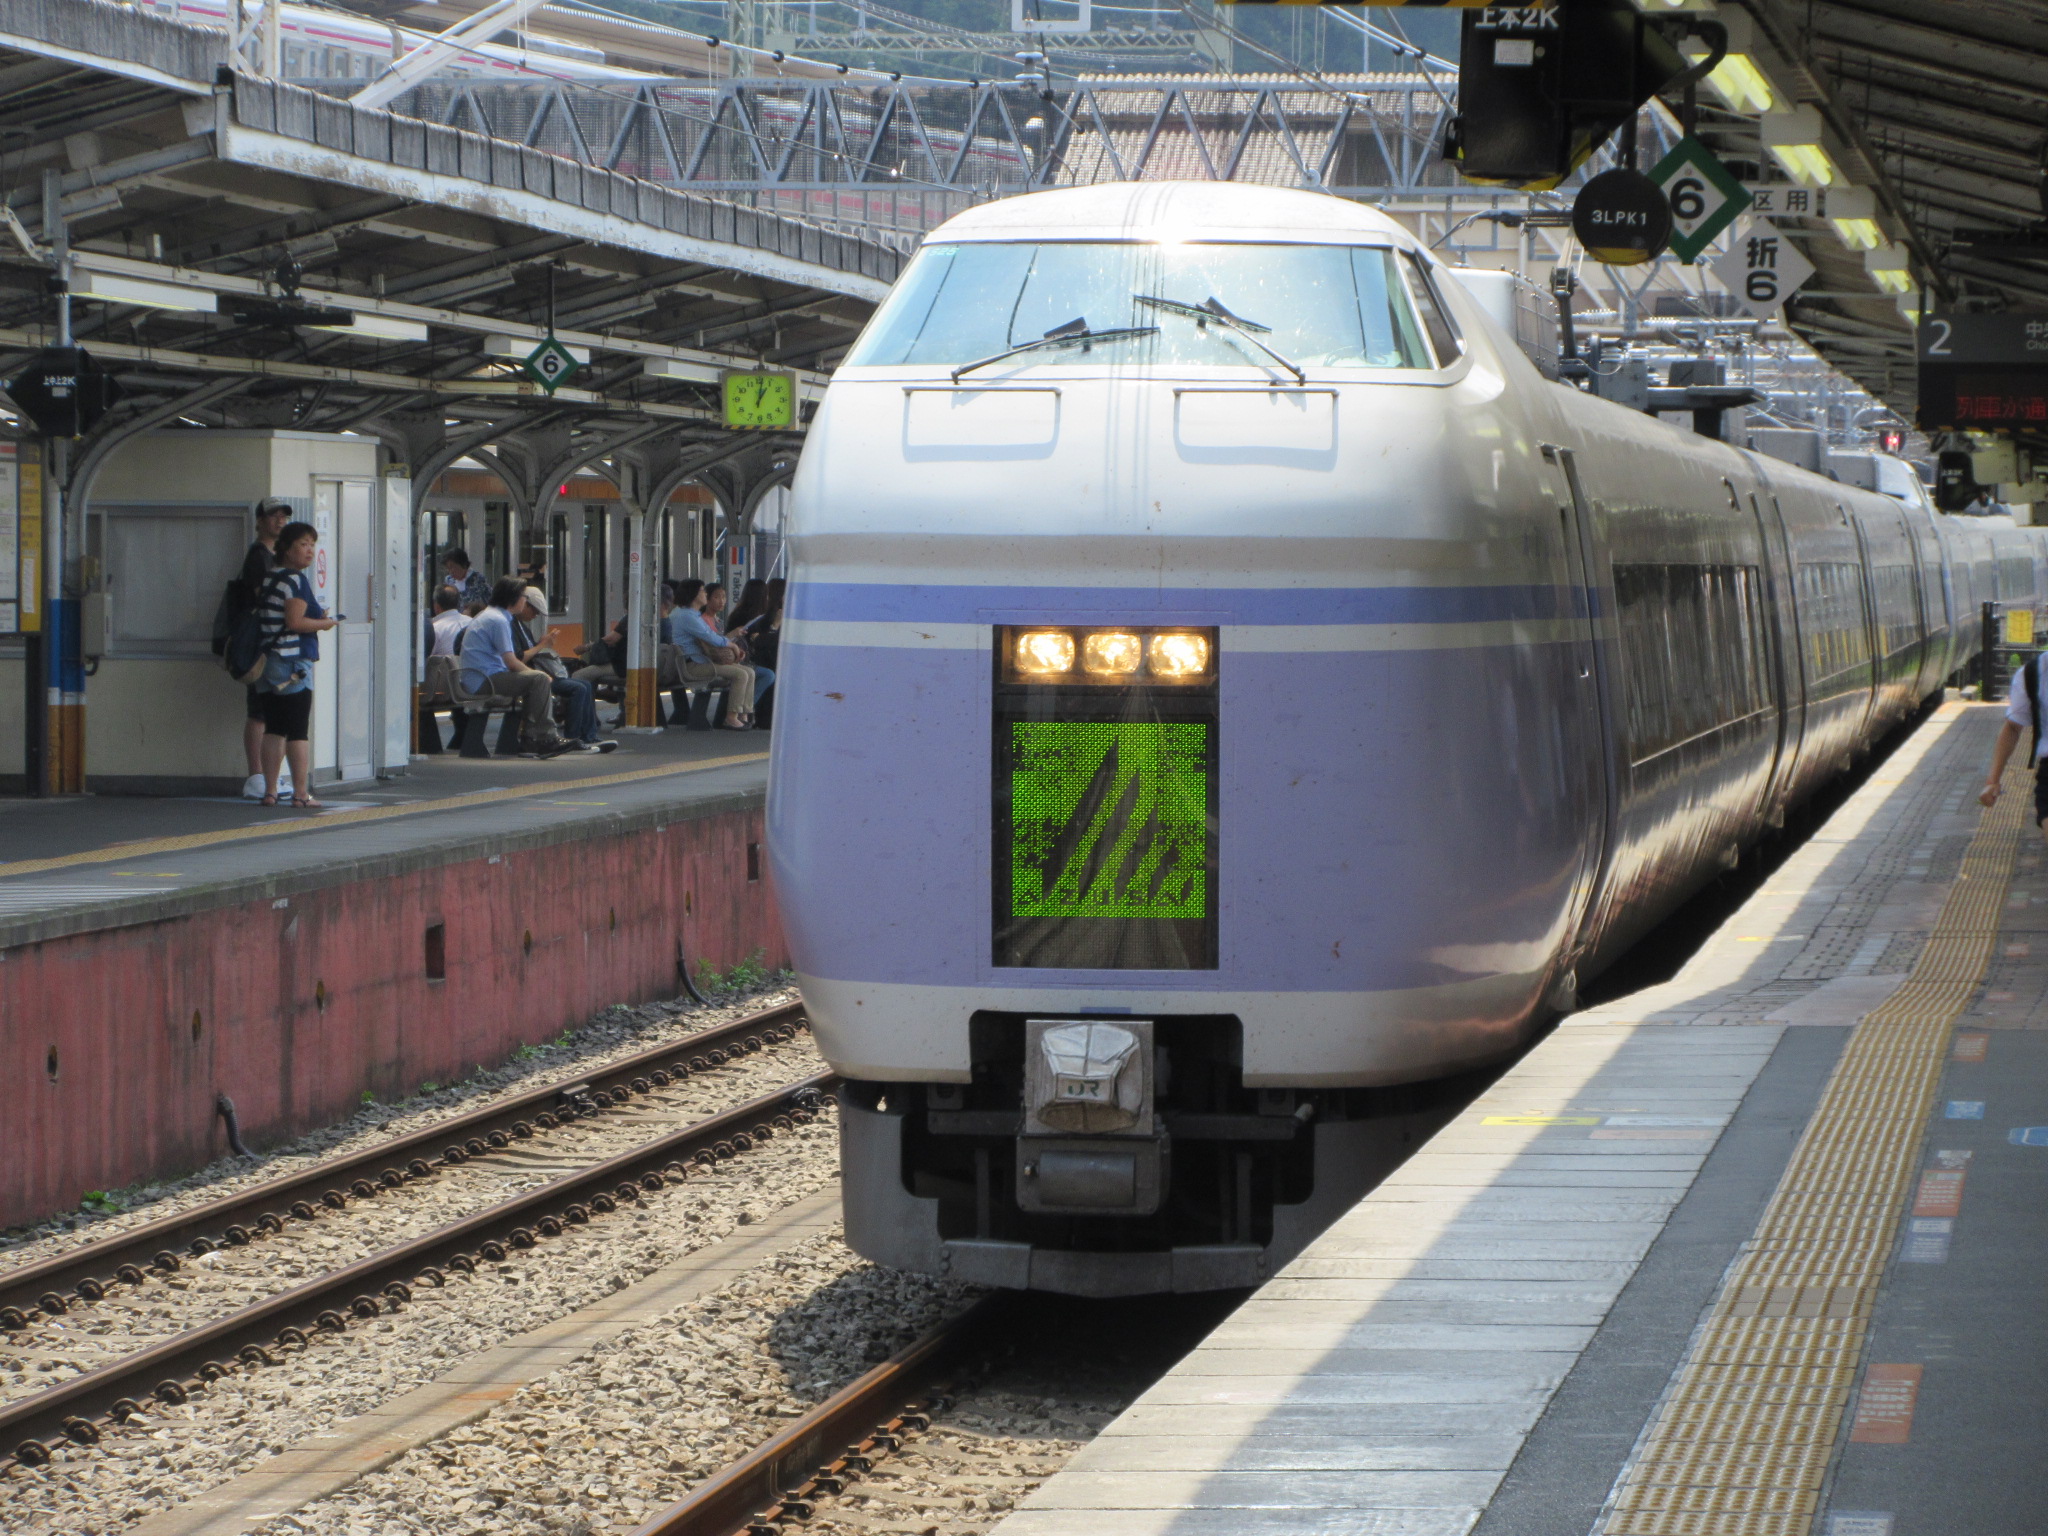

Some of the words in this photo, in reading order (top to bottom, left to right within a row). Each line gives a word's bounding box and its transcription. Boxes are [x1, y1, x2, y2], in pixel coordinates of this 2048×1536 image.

[1669, 177, 1705, 219] 6
[1591, 210, 1647, 225] 3LPK1
[1928, 319, 1952, 354] 2
[542, 354, 559, 374] 6
[733, 570, 742, 603] Takao
